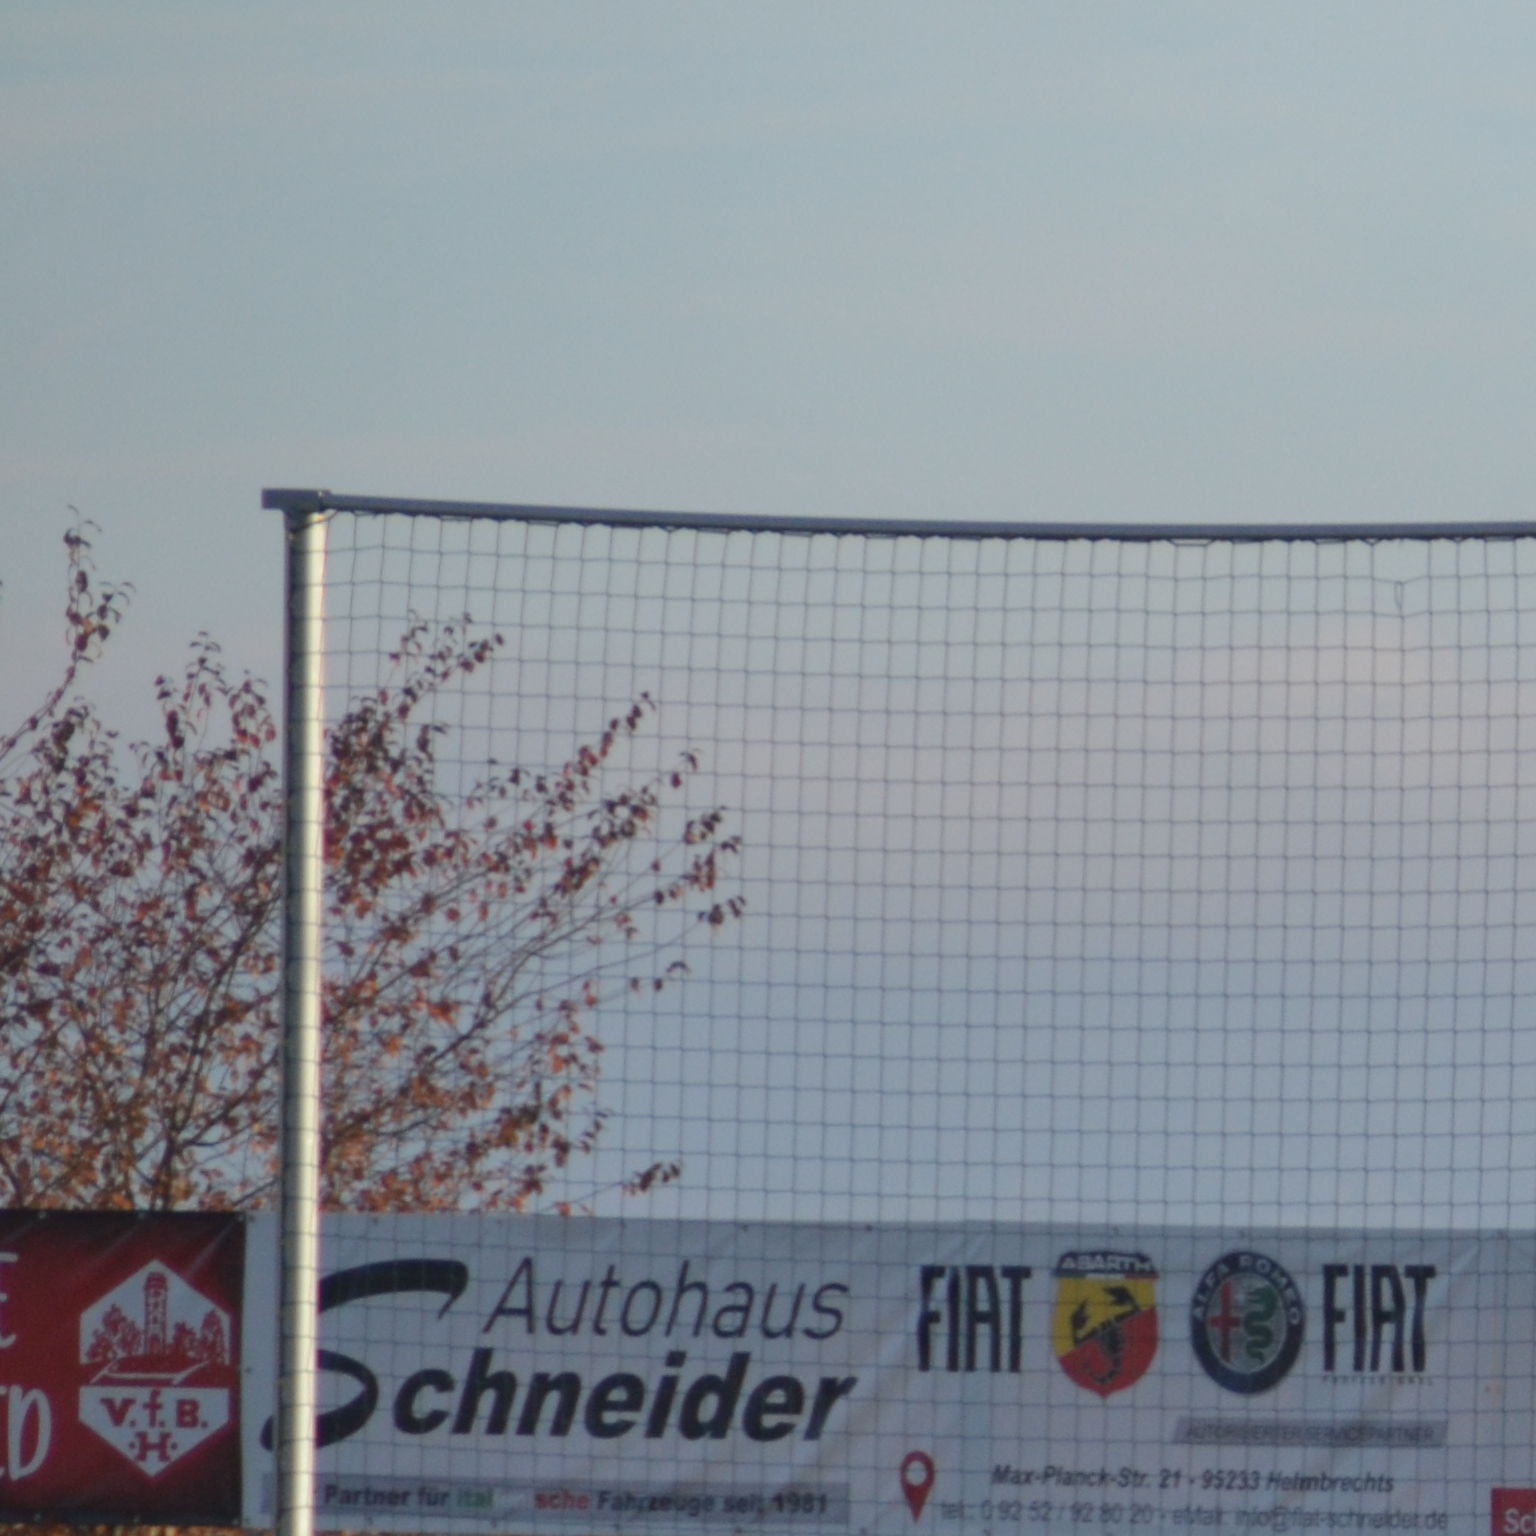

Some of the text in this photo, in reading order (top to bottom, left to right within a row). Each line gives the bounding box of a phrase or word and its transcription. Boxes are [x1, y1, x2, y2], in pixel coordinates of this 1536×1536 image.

[483, 1256, 850, 1340] Autohaus
[1062, 1255, 1151, 1272] ABARTH
[1193, 1255, 1302, 1326] ALFA ROMEO
[260, 1258, 858, 1450] Schneider
[917, 1264, 1031, 1373] FIAT
[1322, 1264, 1436, 1373] FIAT
[324, 1483, 411, 1507] Partner
[772, 1490, 828, 1514] 1981
[991, 1464, 1149, 1489] Max-Planck-Str.
[1159, 1468, 1181, 1489] 21
[1201, 1468, 1262, 1491] 95233
[1265, 1471, 1395, 1493] Helmbrechts
